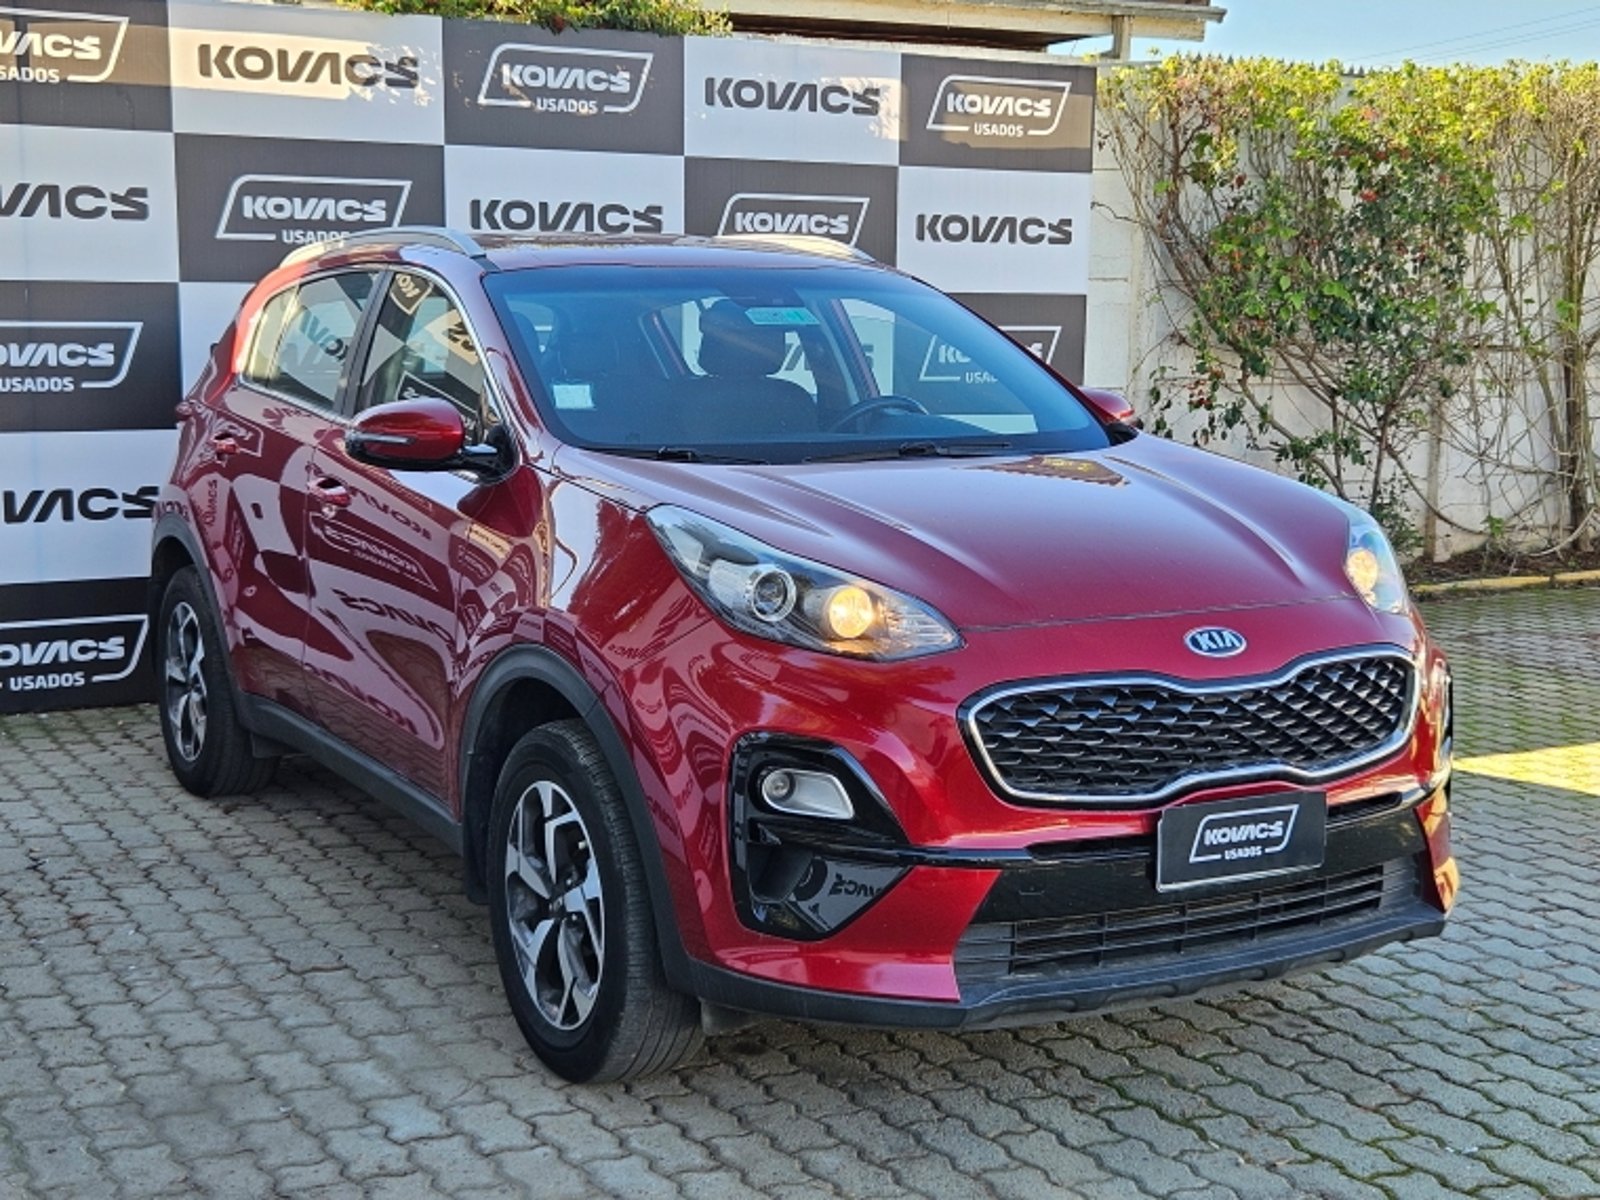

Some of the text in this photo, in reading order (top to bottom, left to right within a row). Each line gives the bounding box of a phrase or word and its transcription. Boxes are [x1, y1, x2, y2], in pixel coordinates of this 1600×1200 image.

[0, 31, 101, 60] VACS
[0, 64, 60, 83] SADOS
[198, 44, 419, 88] KOVACS
[502, 63, 631, 93] KOVACS
[535, 97, 599, 114] USADOS
[704, 77, 880, 116] KOVACS
[946, 92, 1051, 117] KOVACS
[974, 122, 1024, 137] USADOS
[0, 182, 149, 220] VACS
[242, 196, 387, 222] KOVACS
[470, 199, 663, 233] KOVACS
[734, 212, 849, 234] KOVACS
[916, 214, 1072, 245] KOVACS
[0, 343, 115, 367] VACS
[0, 376, 75, 393] USADOS
[3, 486, 159, 524] VACS
[0, 636, 125, 667] OVACS
[1195, 631, 1241, 650] KIA
[10, 671, 85, 691] USADOS
[1204, 821, 1284, 846] KOVACS
[1224, 846, 1263, 860] USADOS
